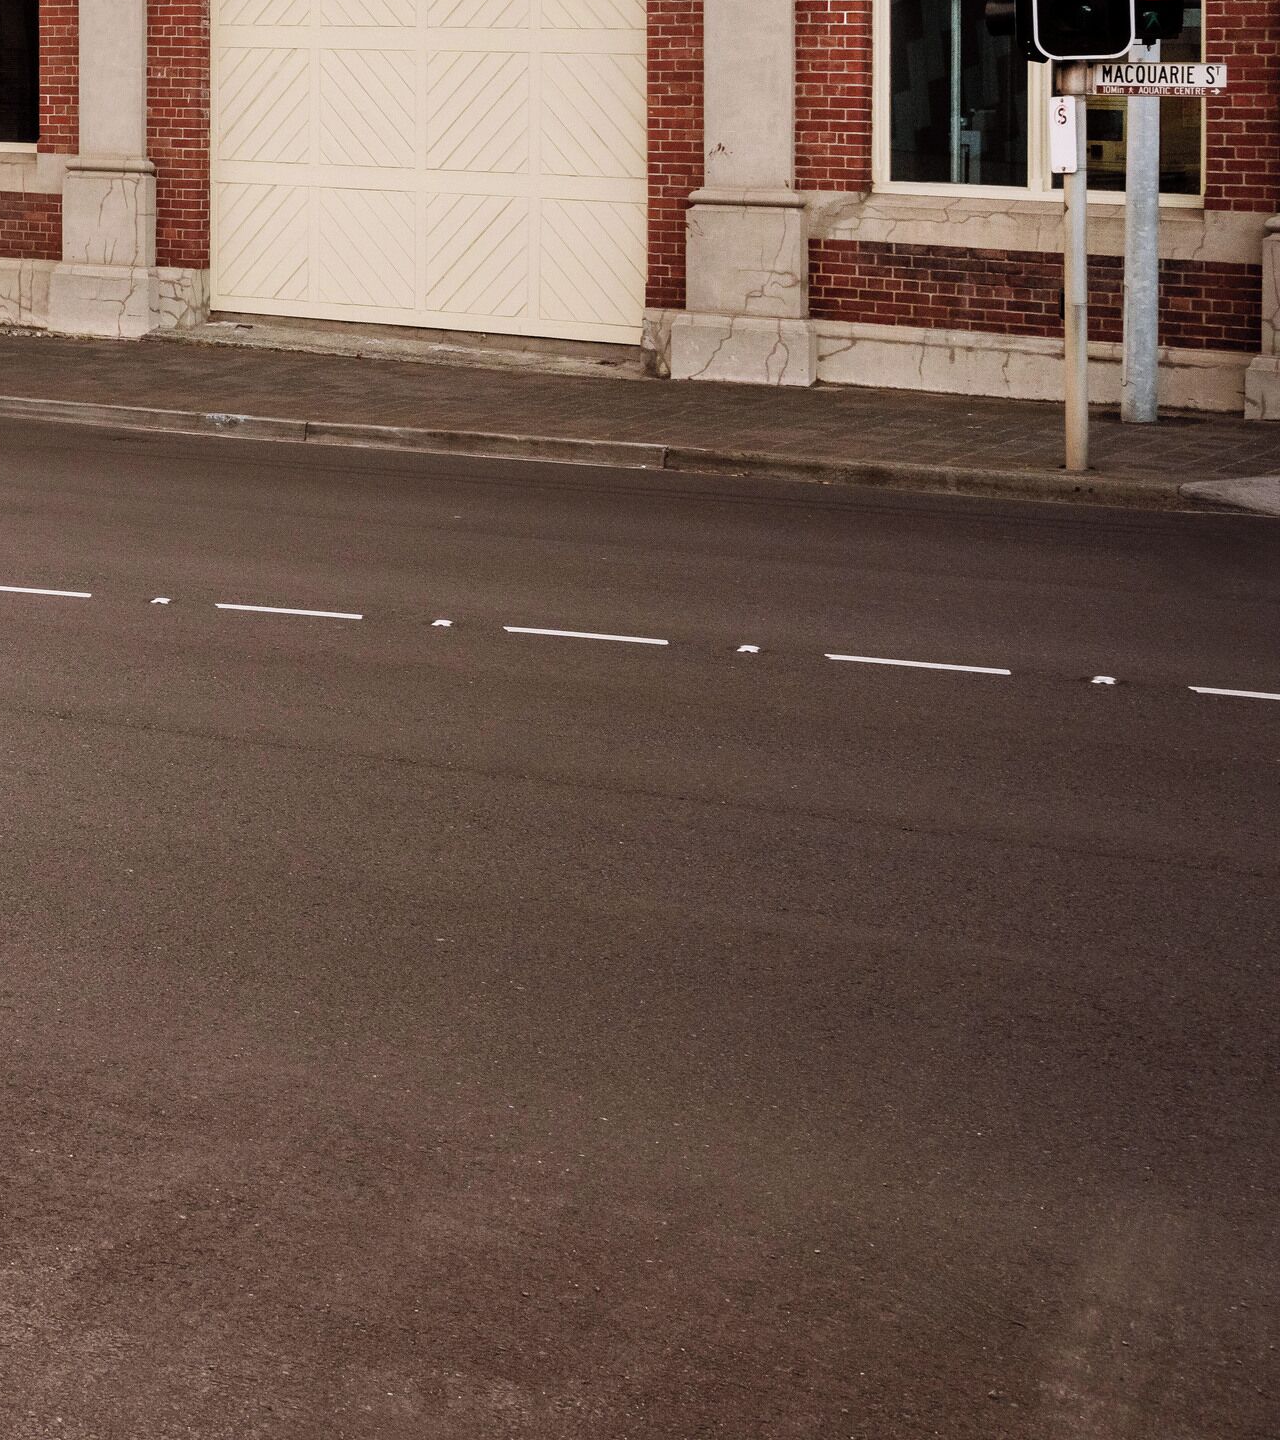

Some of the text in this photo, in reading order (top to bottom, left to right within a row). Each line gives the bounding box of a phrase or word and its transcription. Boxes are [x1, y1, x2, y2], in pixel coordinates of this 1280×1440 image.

[1102, 64, 1195, 84] MACQUARIE
[1103, 85, 1206, 96] 10Min AQUATIC CENTRE
